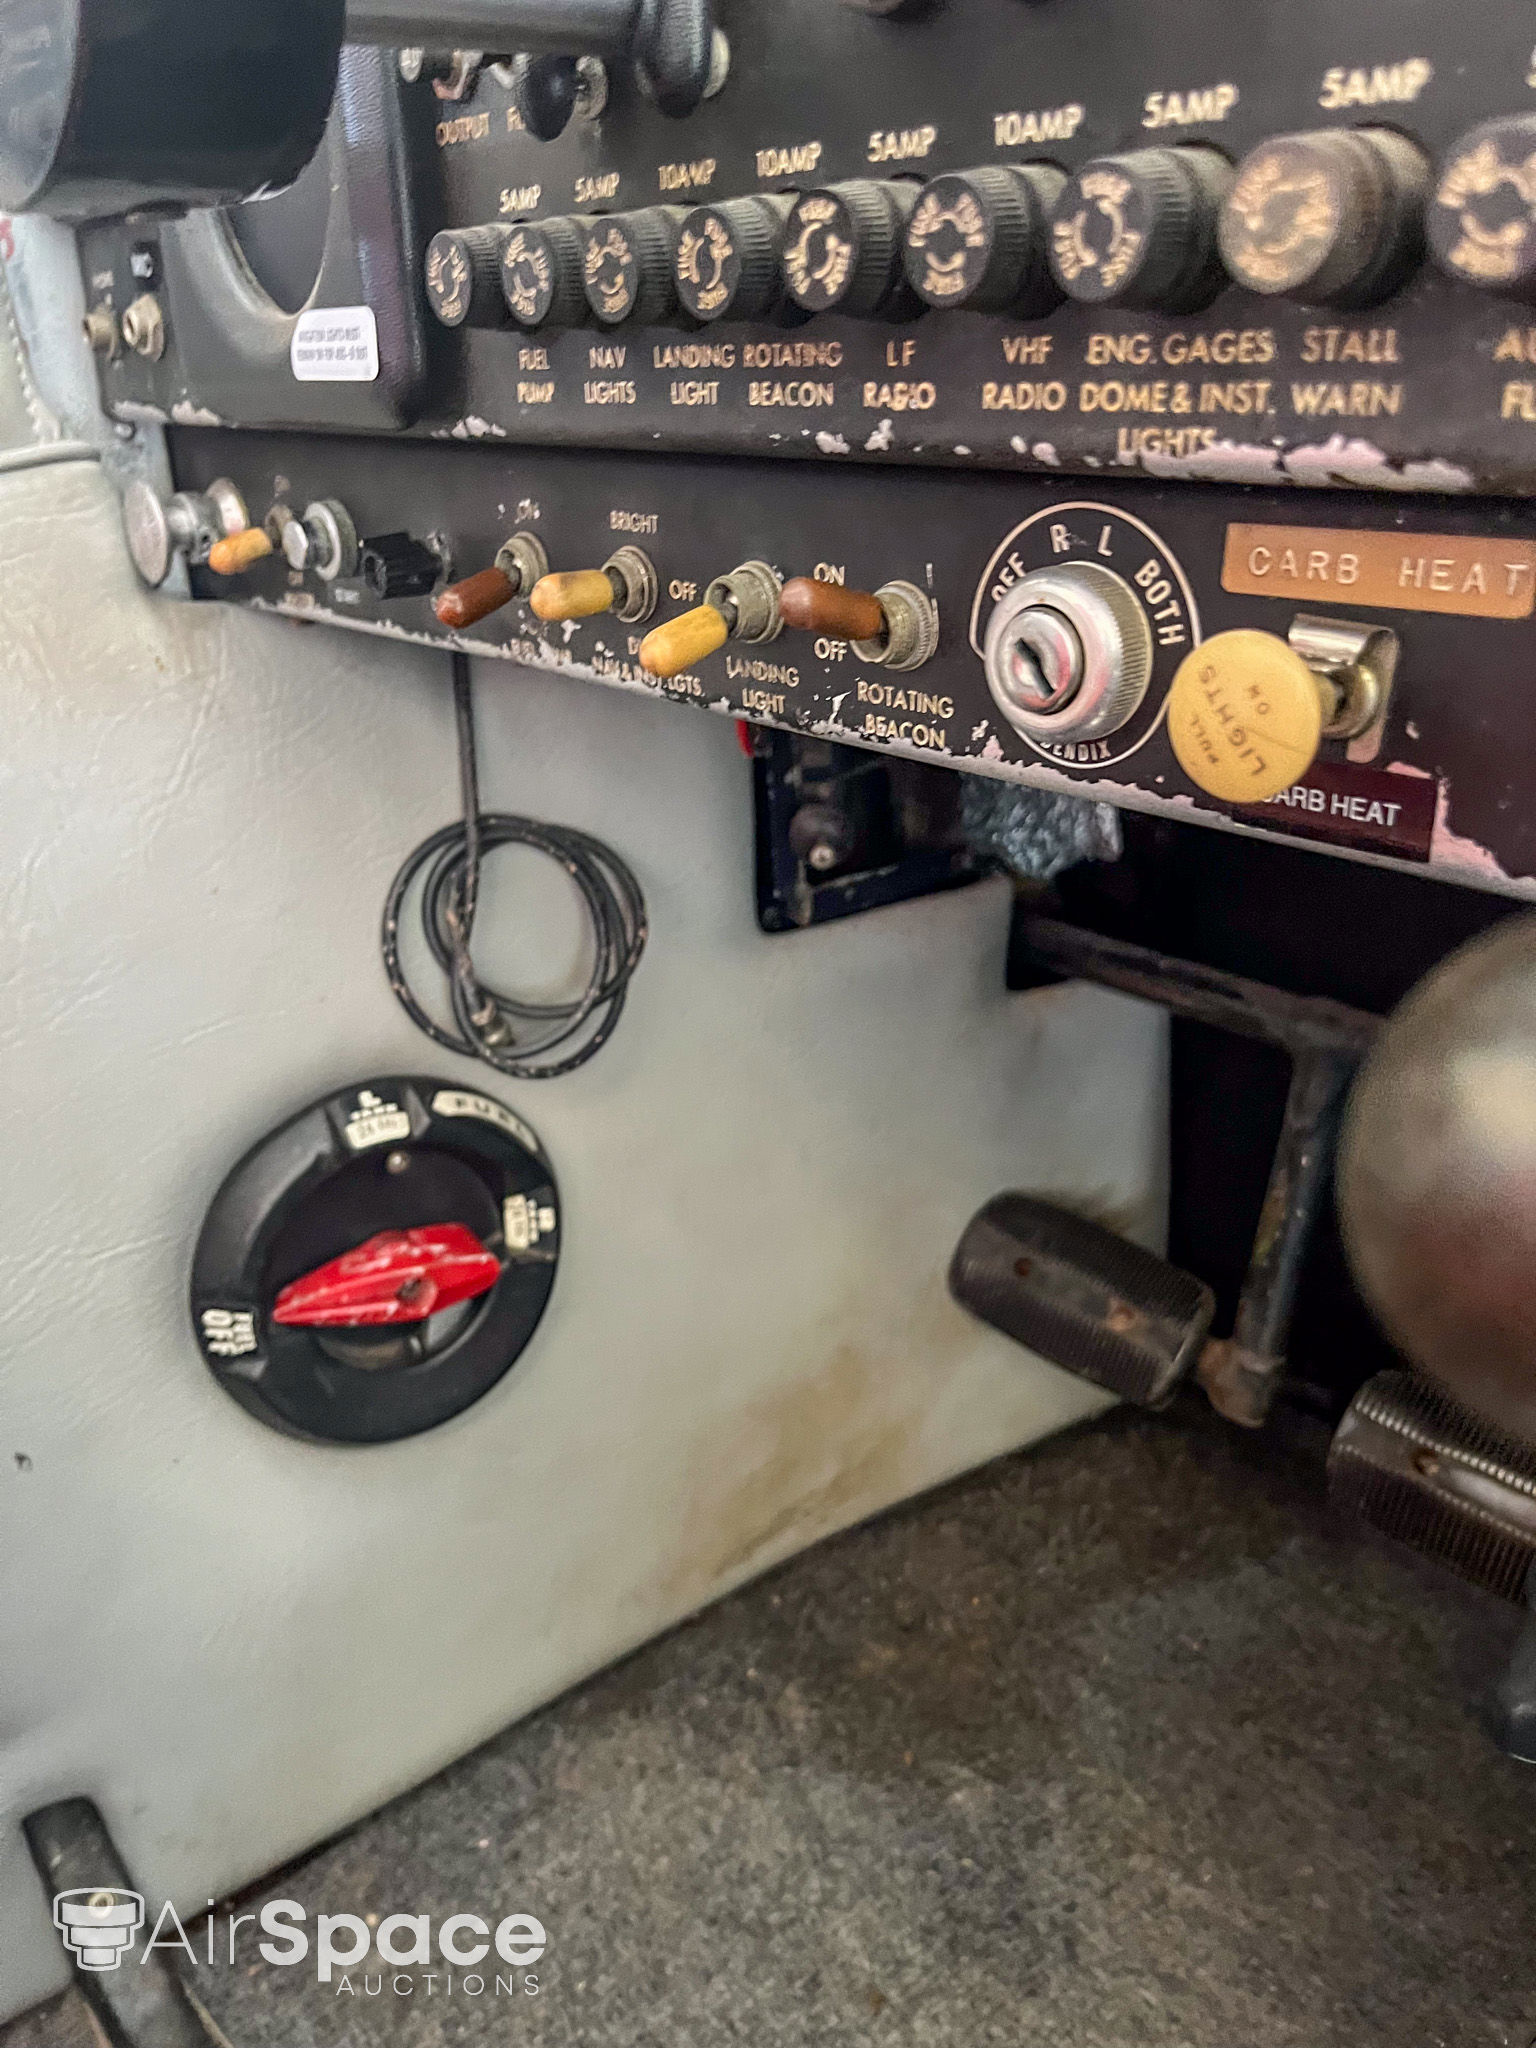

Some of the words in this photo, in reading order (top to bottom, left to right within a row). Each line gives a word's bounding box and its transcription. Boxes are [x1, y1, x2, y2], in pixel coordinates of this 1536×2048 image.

[1319, 57, 1432, 108] 5AMP
[1142, 83, 1239, 128] 5AMP
[994, 103, 1086, 146] 10AMP
[756, 141, 822, 177] 10AMP
[867, 125, 937, 162] 5AMP
[574, 172, 620, 203] 5AMP
[658, 158, 717, 190] 10AMP
[500, 184, 541, 214] 5AMP
[518, 347, 550, 371] FUEL
[589, 345, 626, 369] NAV
[653, 344, 735, 369] LANDING
[1001, 334, 1053, 364] VHF
[1161, 329, 1276, 365] GAGES
[1302, 327, 1400, 364] STALL
[517, 381, 555, 404] PUMP
[583, 380, 637, 405] LIGHTS
[670, 380, 720, 405] LIGHT
[749, 381, 835, 407] BEACON
[982, 381, 1067, 411] RADIO
[1079, 381, 1165, 412] DOME
[1170, 381, 1192, 414] &
[1292, 383, 1402, 417] WARN
[609, 510, 659, 534] BRIGHT
[812, 561, 845, 587] ON
[990, 552, 1027, 602] OFF
[1050, 523, 1070, 554] R
[1097, 524, 1114, 557] L
[1133, 558, 1186, 646] BOTH
[1248, 545, 1360, 586] CARB
[1398, 554, 1530, 597] HEAT
[668, 578, 698, 603] OFF
[813, 637, 848, 662] OFF
[726, 655, 800, 688] LANDING
[742, 687, 786, 714] LIGHT
[857, 680, 955, 719] ROTATING
[1198, 664, 1267, 777] LIGHTS
[1040, 739, 1112, 762] ENDIX
[1330, 793, 1403, 827] HEAT
